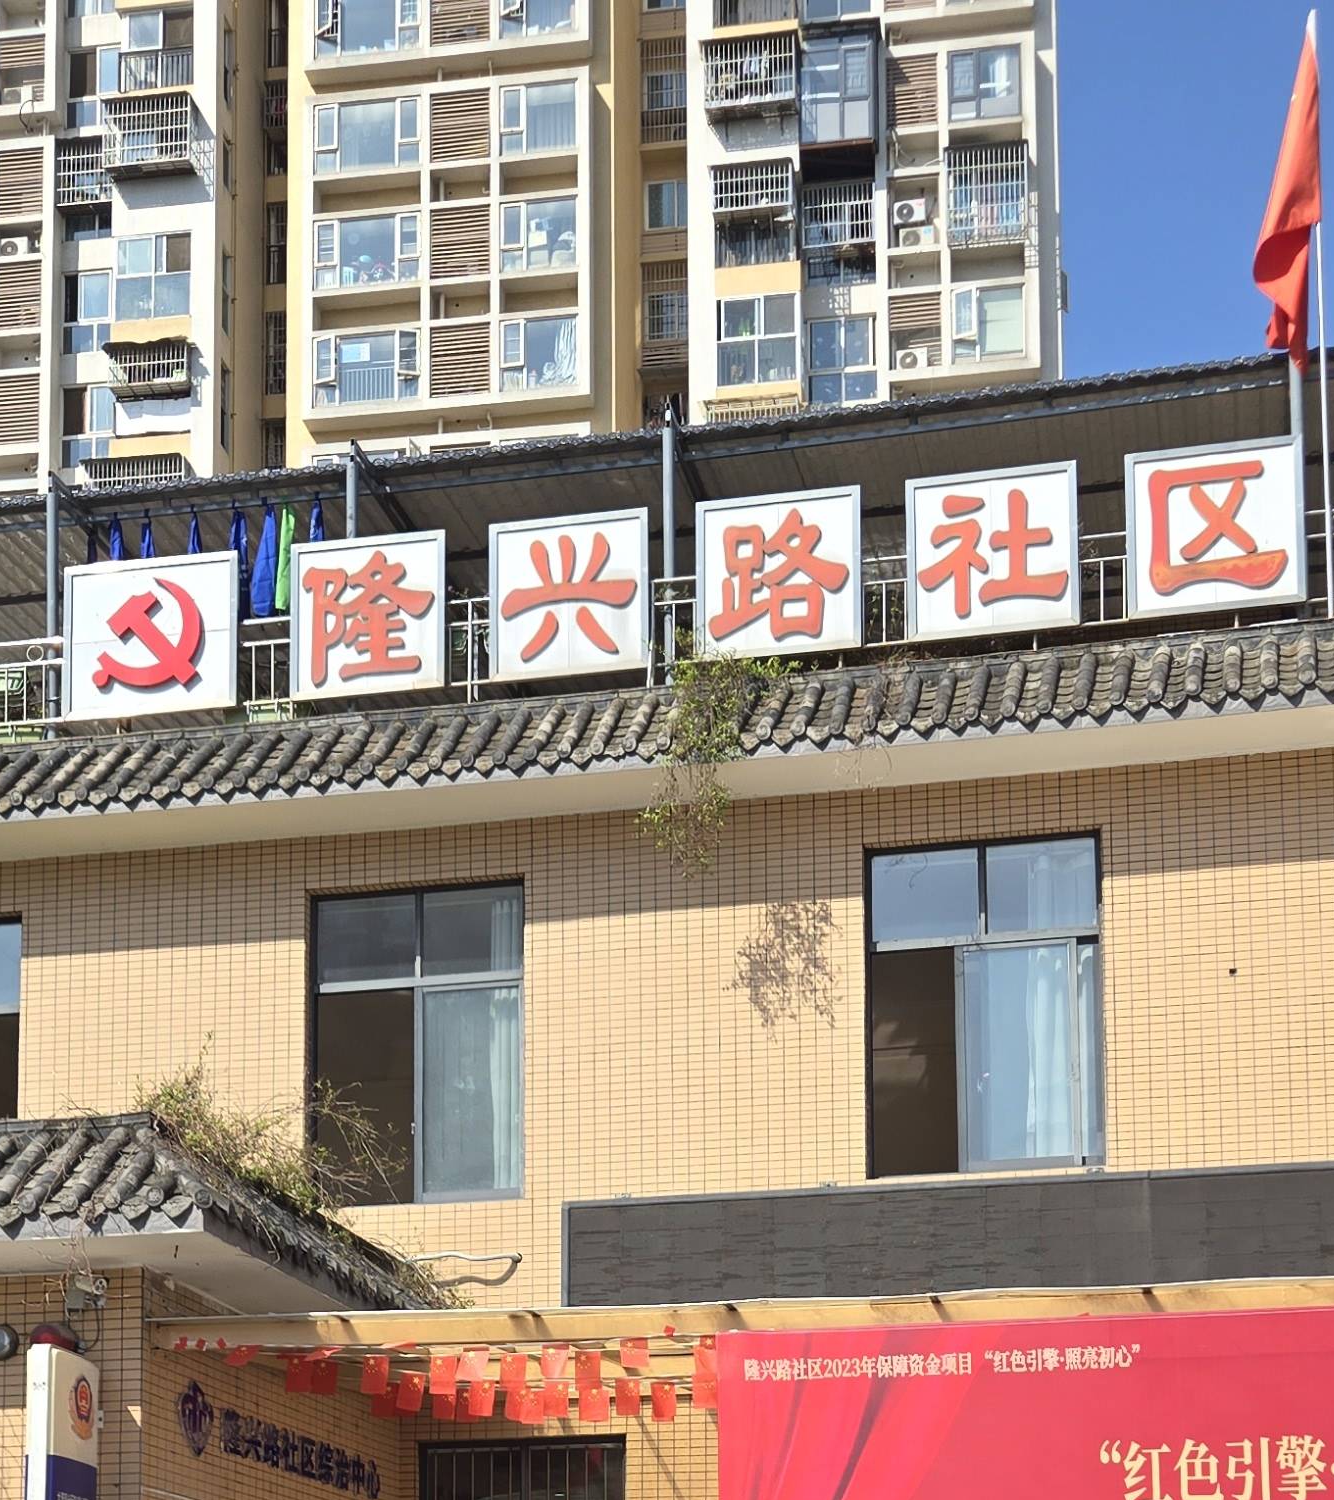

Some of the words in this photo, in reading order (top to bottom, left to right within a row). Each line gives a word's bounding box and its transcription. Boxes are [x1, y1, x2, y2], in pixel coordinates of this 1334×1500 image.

[744, 1351, 972, 1381] 隆兴路社区2023年保障资金项目
[220, 1408, 380, 1499] 隆兴路社区综治中心
